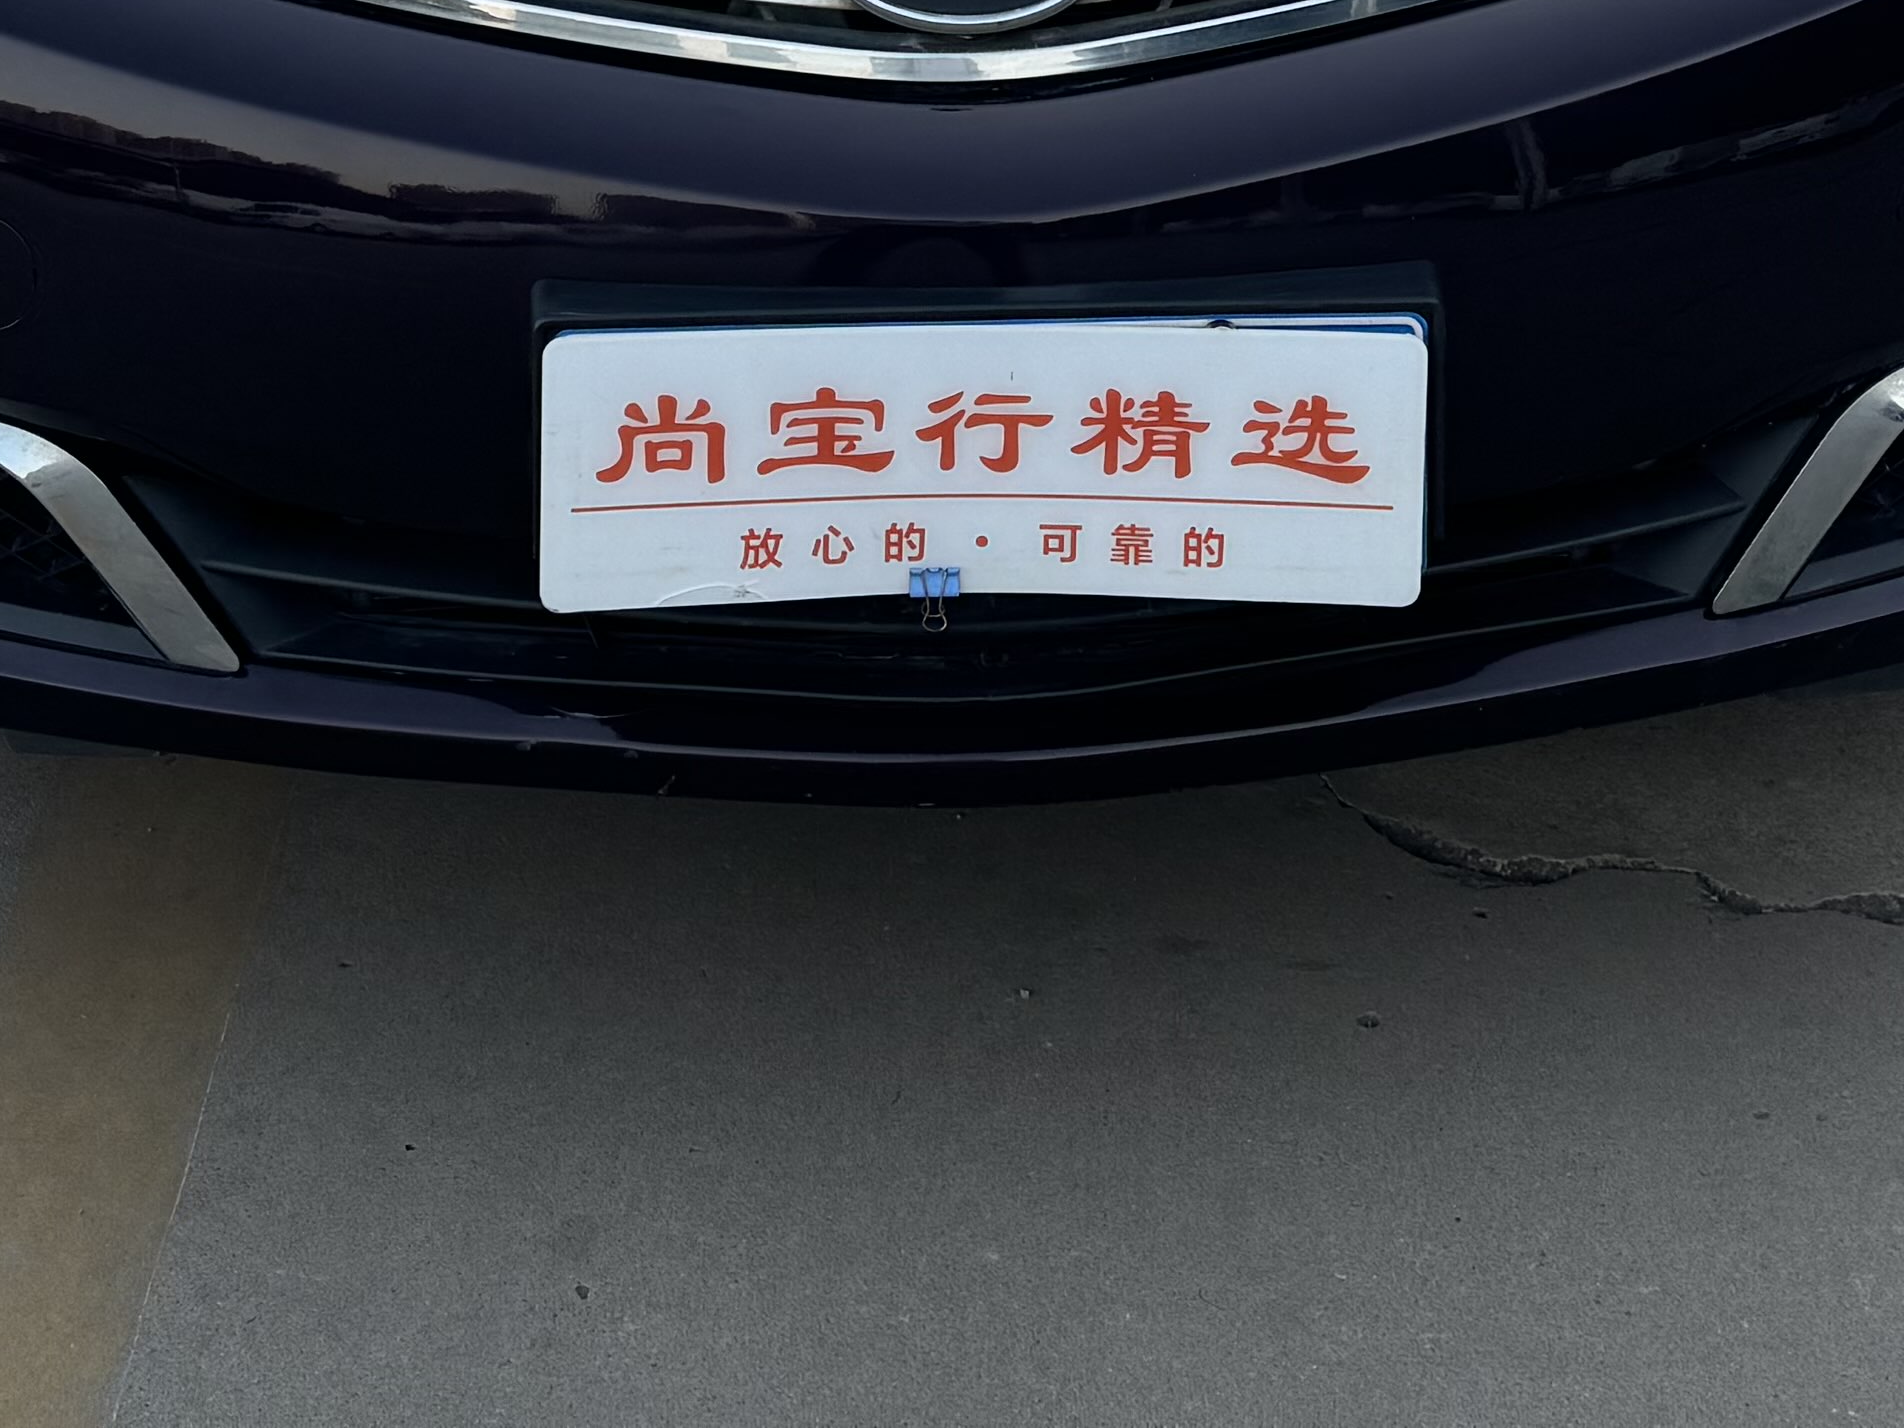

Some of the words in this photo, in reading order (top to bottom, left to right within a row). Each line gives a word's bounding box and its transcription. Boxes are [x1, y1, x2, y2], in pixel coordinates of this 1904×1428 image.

[595, 386, 1372, 485] 尚宝行精选
